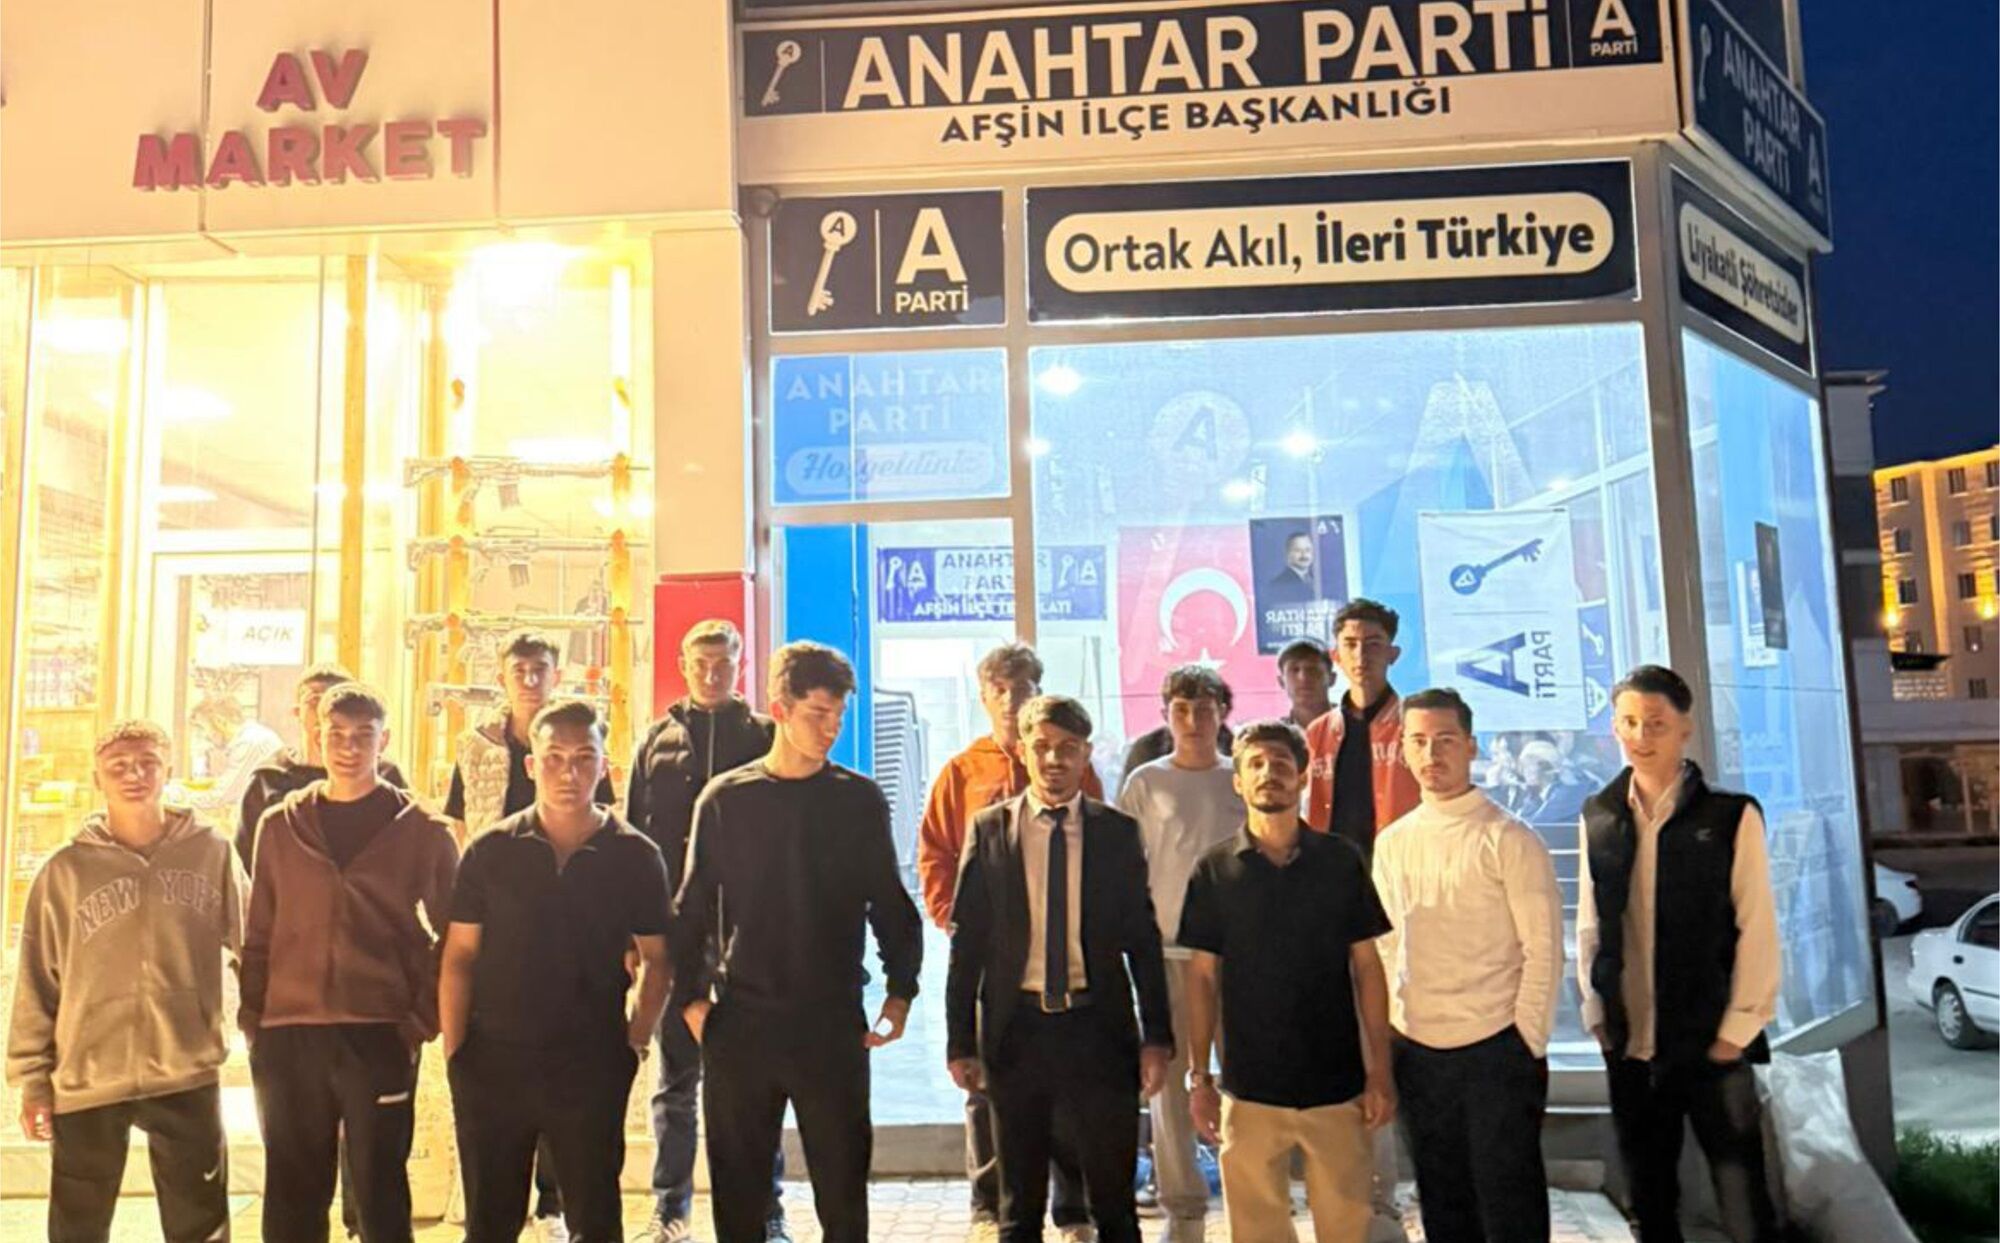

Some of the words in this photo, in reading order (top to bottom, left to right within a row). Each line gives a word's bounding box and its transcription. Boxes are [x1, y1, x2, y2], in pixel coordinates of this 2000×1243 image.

[1590, 0, 1636, 38] A
[1590, 36, 1639, 56] PARTİ
[256, 48, 368, 112] AV
[842, 15, 1262, 108] ANAHTAR
[1303, 0, 1551, 83] PARTİ
[940, 109, 1064, 147] AFŞİN
[1080, 98, 1170, 141] İLÇE
[1185, 82, 1452, 134] BAŞKANLIĞI
[1723, 30, 1800, 150] ANAHTAR
[133, 119, 487, 191] MARKET
[896, 207, 967, 284] A
[1064, 226, 1189, 274] Ortak
[1205, 220, 1302, 273] Akıl,
[1315, 210, 1404, 264] İleri
[1418, 212, 1596, 267] Türkiye
[895, 284, 969, 313] PARTİ
[786, 364, 992, 401] ANAHTAR
[829, 395, 952, 435] PARTİ
[942, 553, 1048, 568] ANAHTR
[77, 876, 140, 944] NEW
